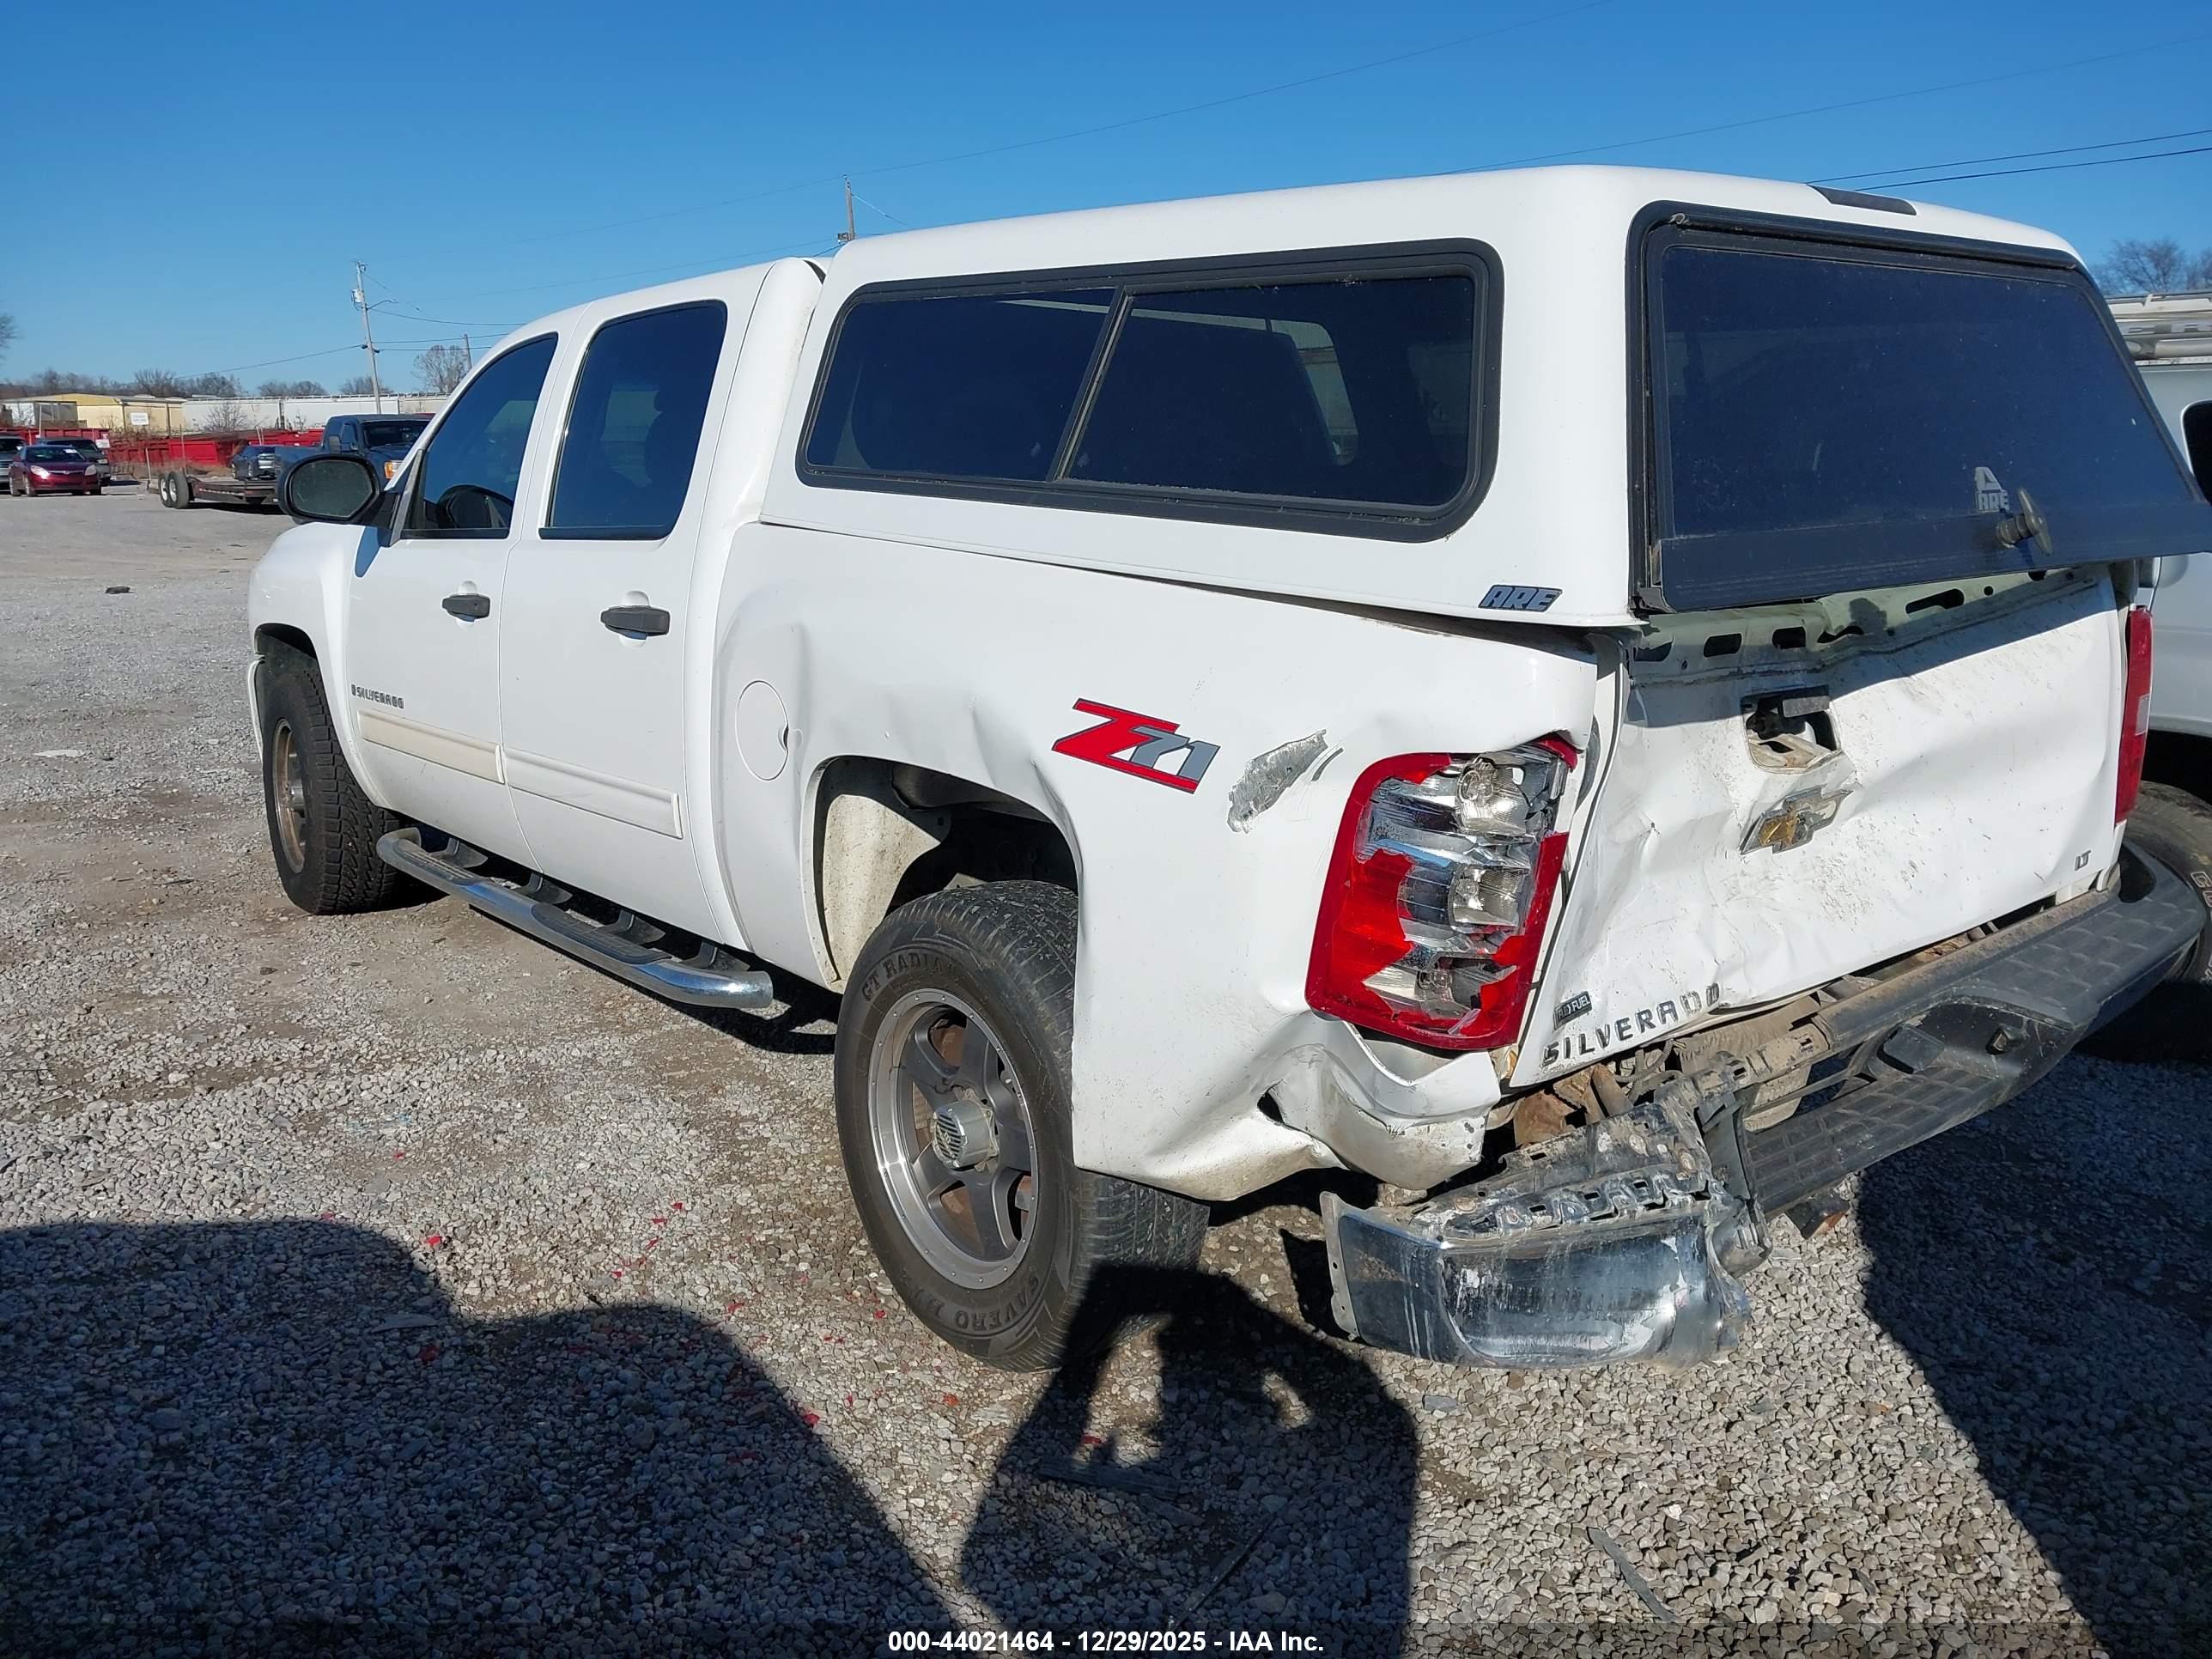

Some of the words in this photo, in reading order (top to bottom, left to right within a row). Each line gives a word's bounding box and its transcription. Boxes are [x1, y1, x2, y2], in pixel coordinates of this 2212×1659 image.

[1978, 492, 2009, 512] ARE
[1479, 585, 1561, 611] ARE
[356, 686, 404, 708] SILVERADO
[1050, 697, 1222, 795] Z71
[2075, 849, 2092, 872] LT
[861, 969, 882, 1002] GT
[1542, 982, 1722, 1065] SILVERADO
